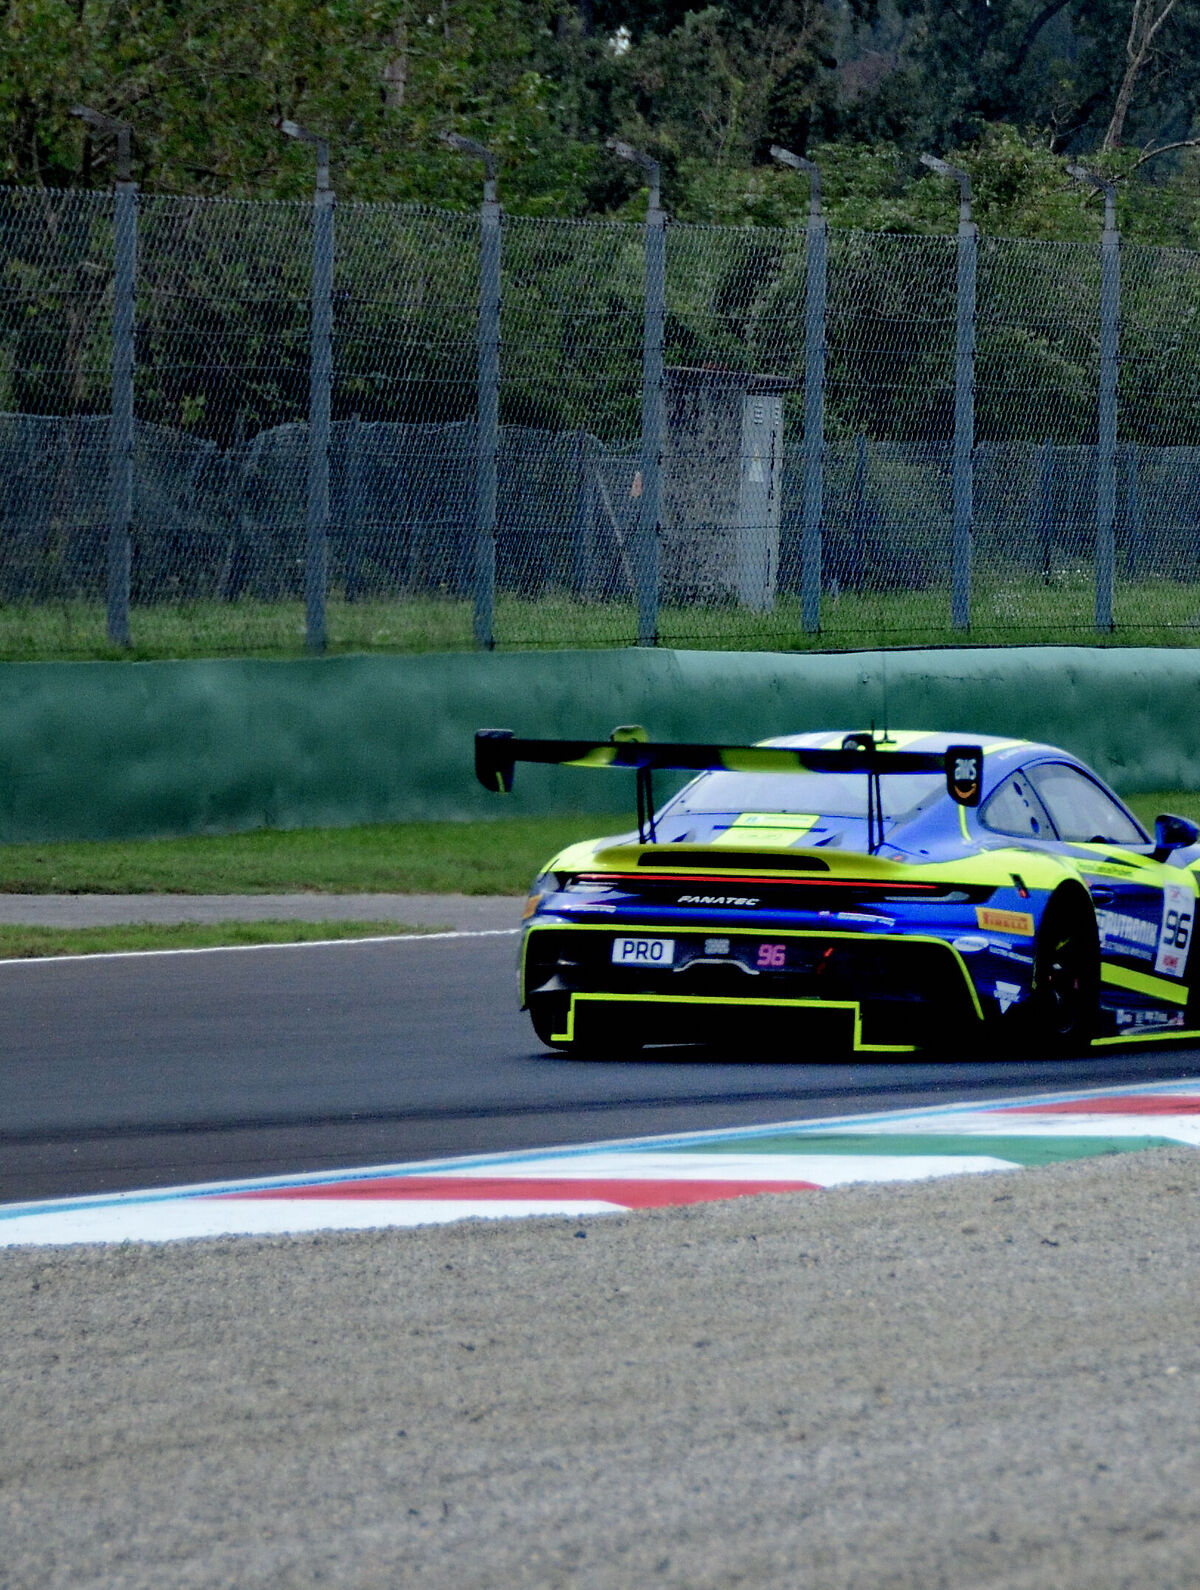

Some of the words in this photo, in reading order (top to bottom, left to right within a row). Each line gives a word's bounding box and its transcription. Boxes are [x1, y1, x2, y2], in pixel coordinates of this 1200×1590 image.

[677, 895, 760, 906] FANATEC
[1163, 909, 1191, 949] 96
[622, 941, 664, 961] PRO
[757, 943, 787, 967] 96
